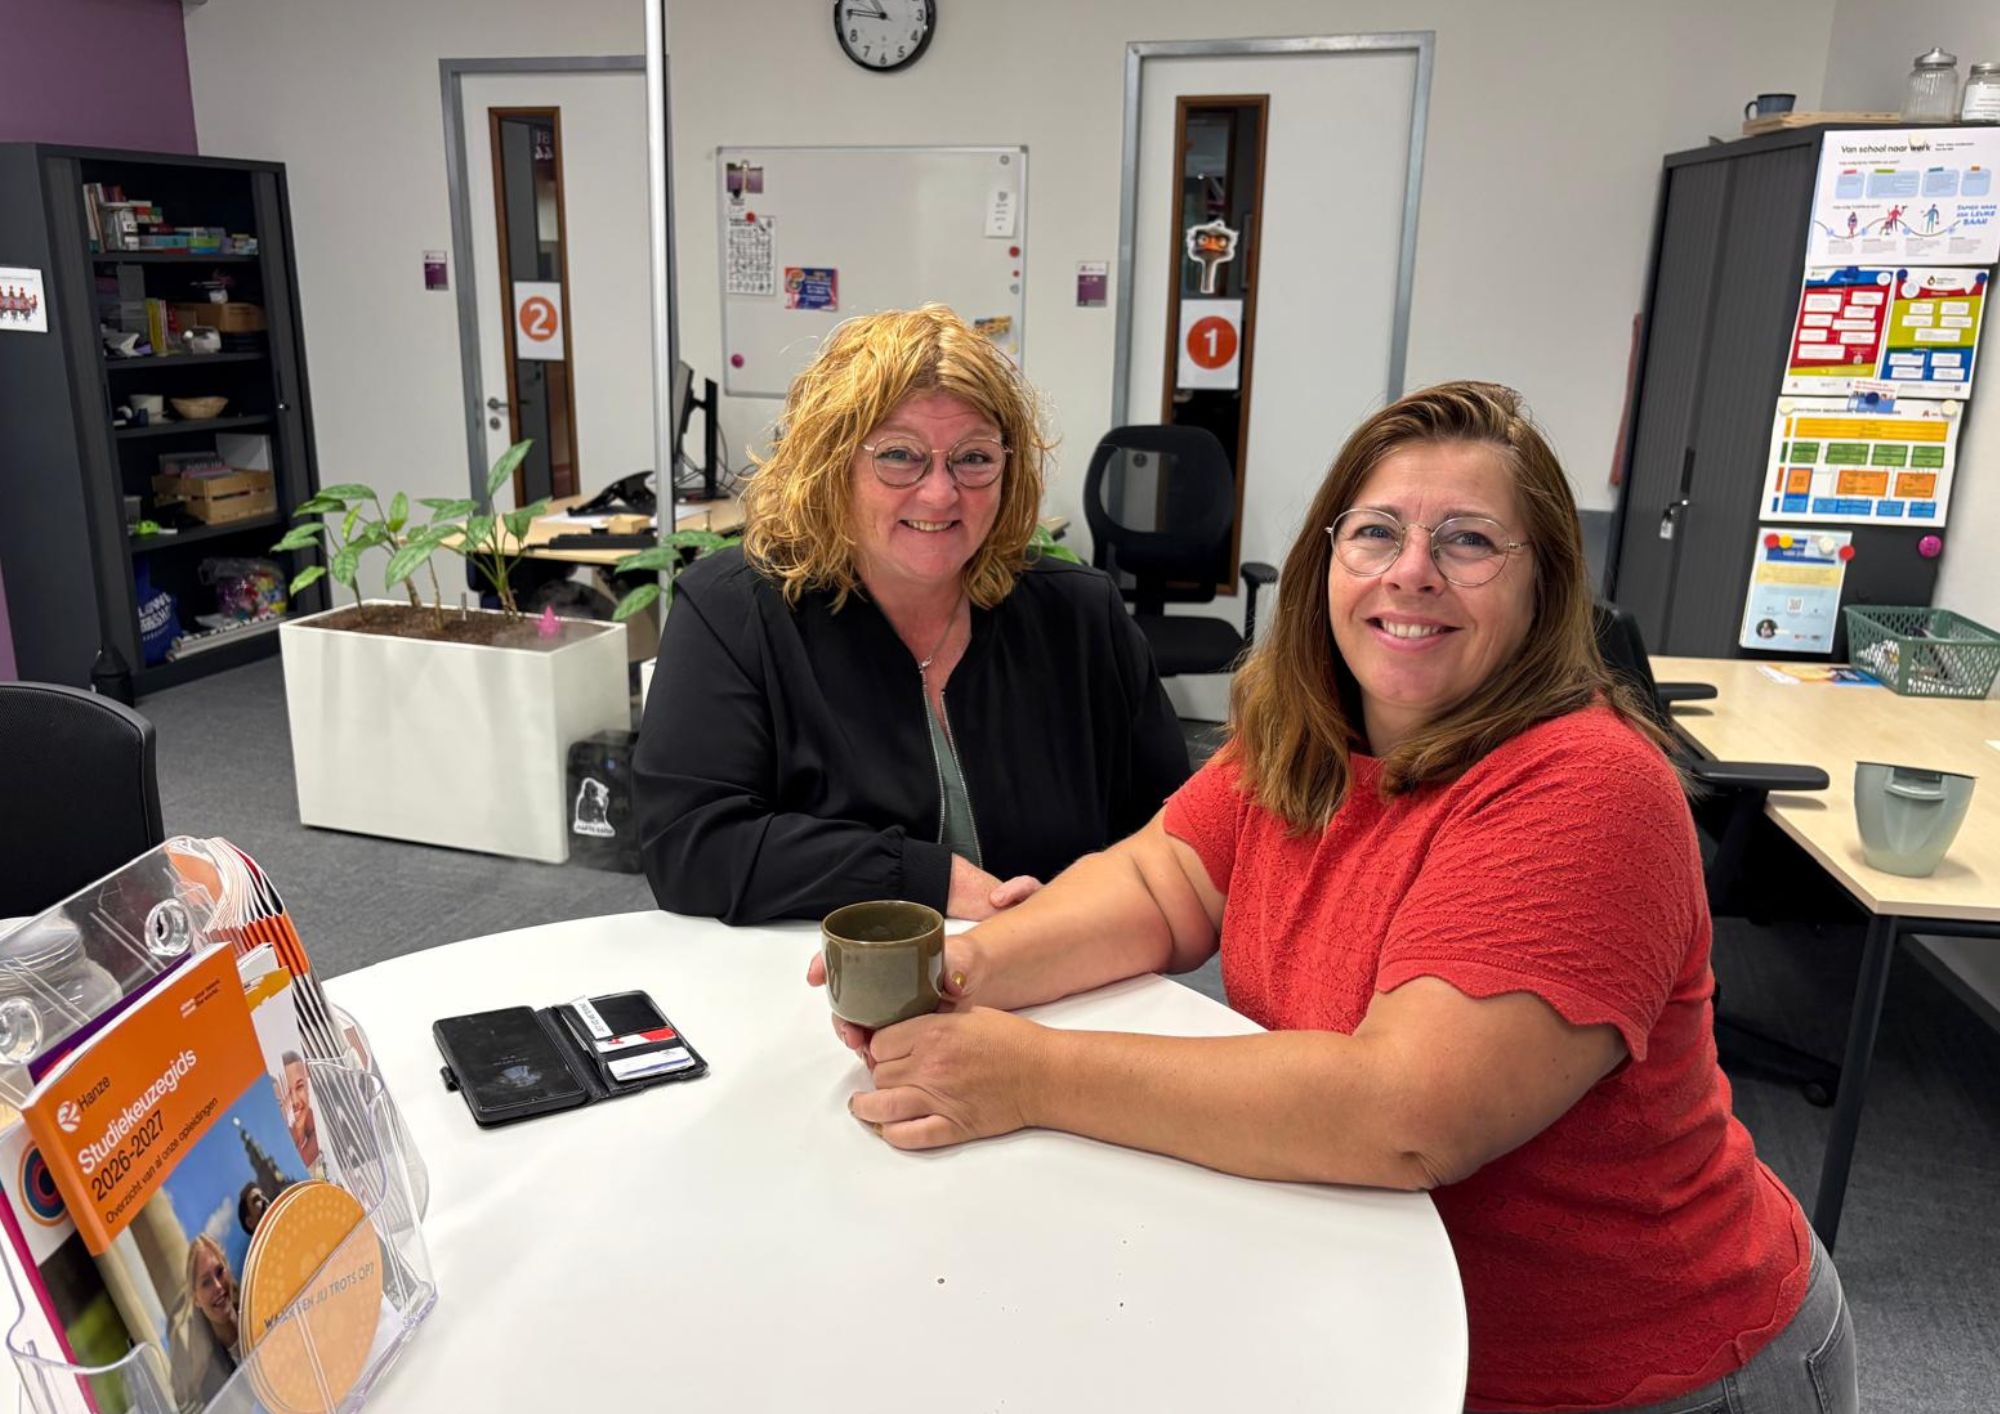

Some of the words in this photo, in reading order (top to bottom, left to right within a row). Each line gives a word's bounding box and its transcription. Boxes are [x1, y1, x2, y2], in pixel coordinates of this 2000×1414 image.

[849, 29, 858, 43] 8
[910, 30, 918, 42] 4
[863, 45, 871, 58] 7
[880, 52, 887, 65] 6
[897, 45, 905, 58] 5
[1841, 145, 1857, 153] Van
[1859, 144, 1887, 153] school
[1888, 145, 1908, 153] naar
[528, 303, 551, 335] 2
[1203, 328, 1219, 358] 1
[76, 1076, 111, 1112] Hanze
[78, 1049, 198, 1175] Studiekeuzegids
[91, 1109, 165, 1202] 2026-2027
[105, 1184, 143, 1224] Overzicht
[142, 1168, 157, 1186] van
[162, 1139, 180, 1160] onze
[178, 1097, 219, 1141] opleidingen
[330, 1274, 357, 1297] TROTS
